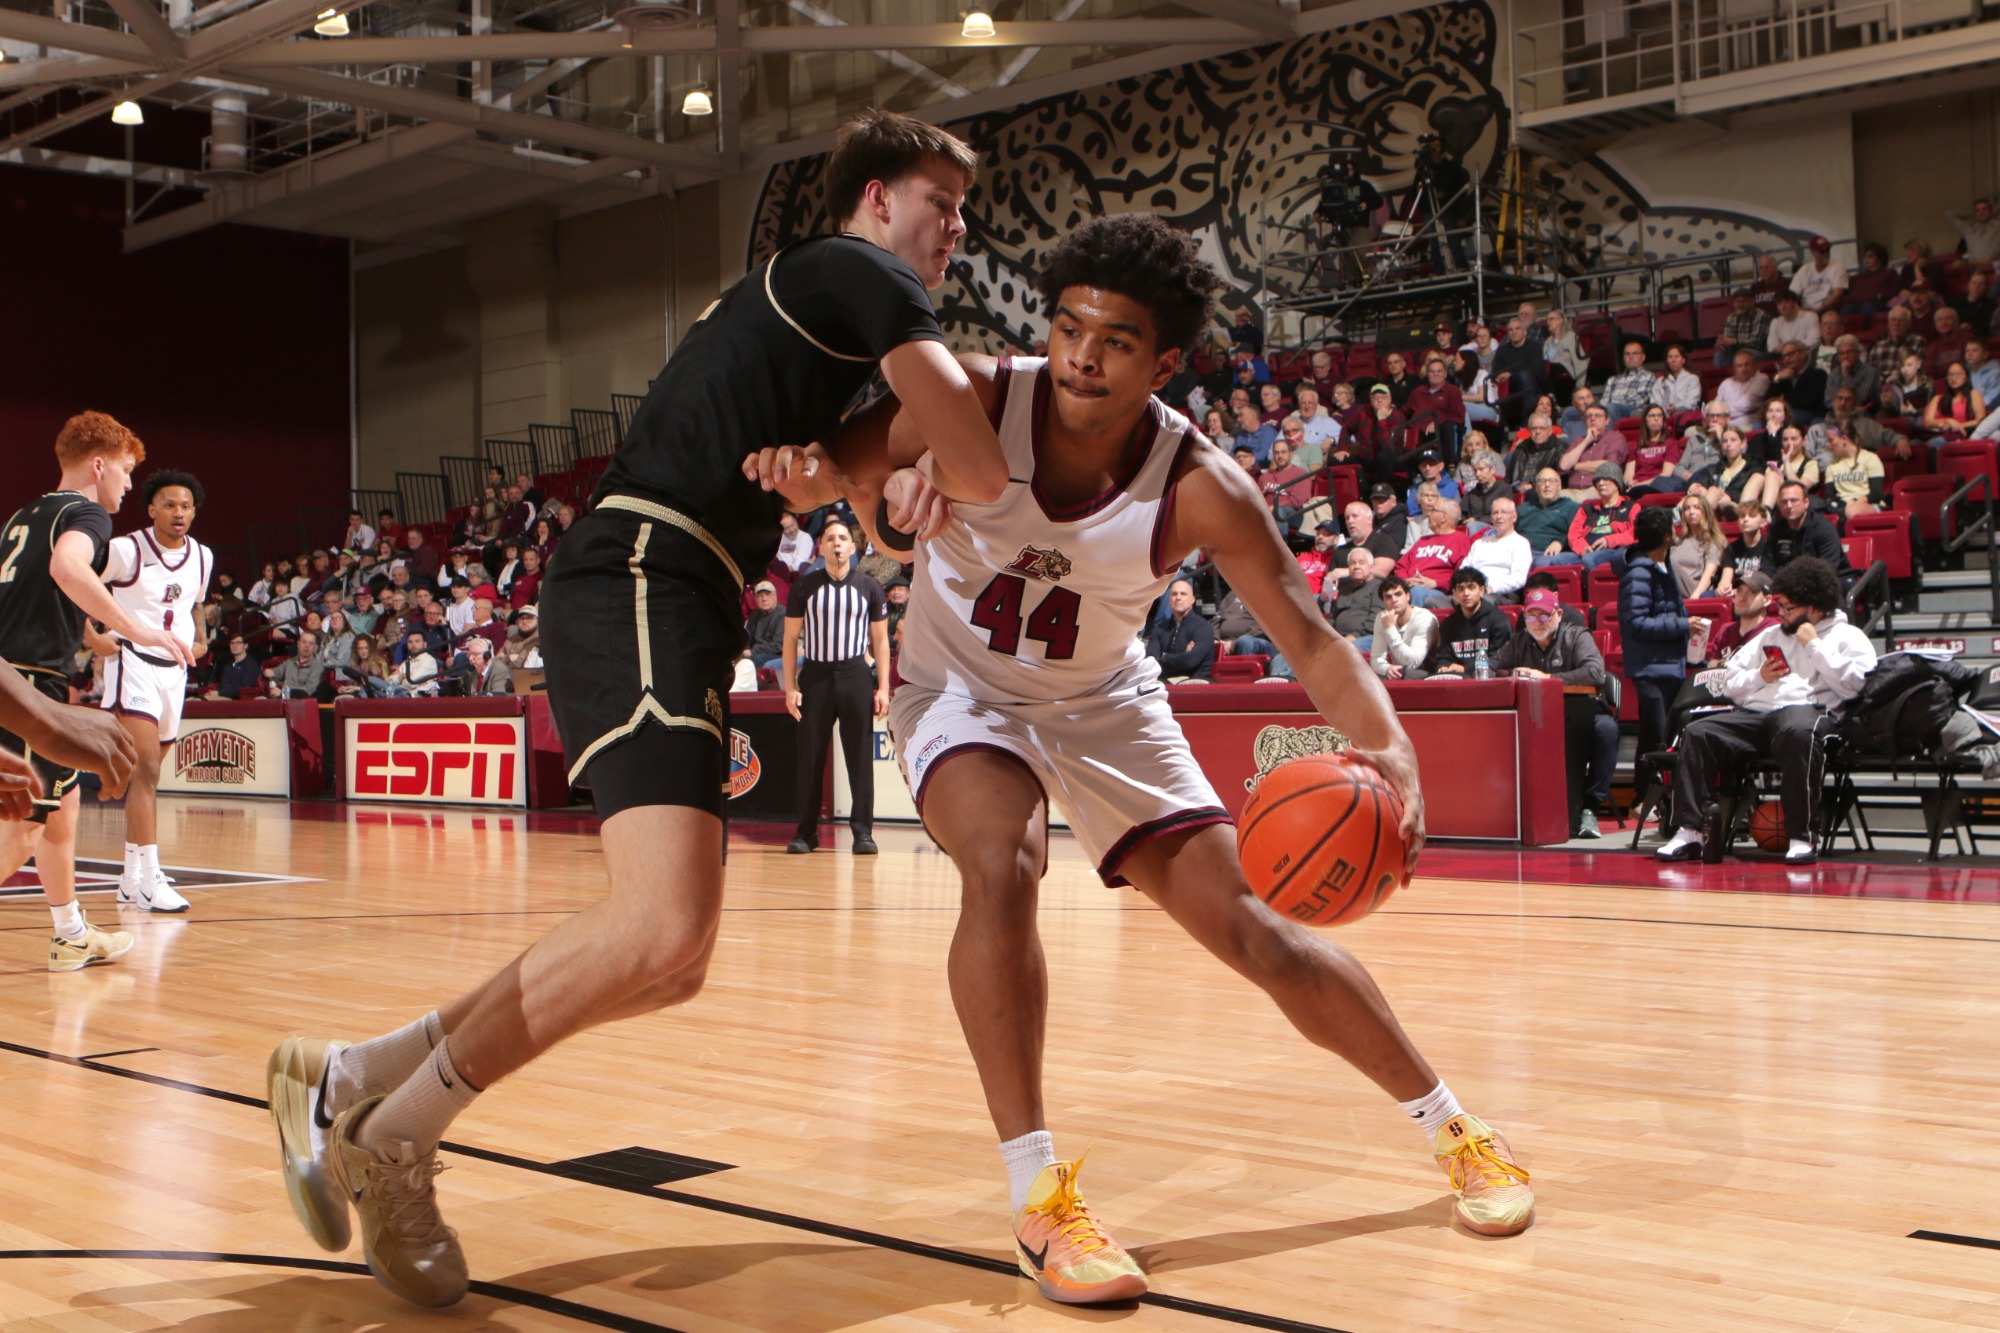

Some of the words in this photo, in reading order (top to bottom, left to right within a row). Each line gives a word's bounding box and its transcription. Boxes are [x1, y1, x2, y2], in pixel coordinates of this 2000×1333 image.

[0, 525, 29, 583] 2
[971, 572, 1082, 659] 44
[176, 729, 255, 779] LAFAYETTE
[187, 766, 221, 782] MAROON
[222, 766, 244, 783] CLUB
[355, 723, 516, 799] ESPN
[730, 732, 749, 767] TE
[1289, 858, 1357, 922] ELITE
